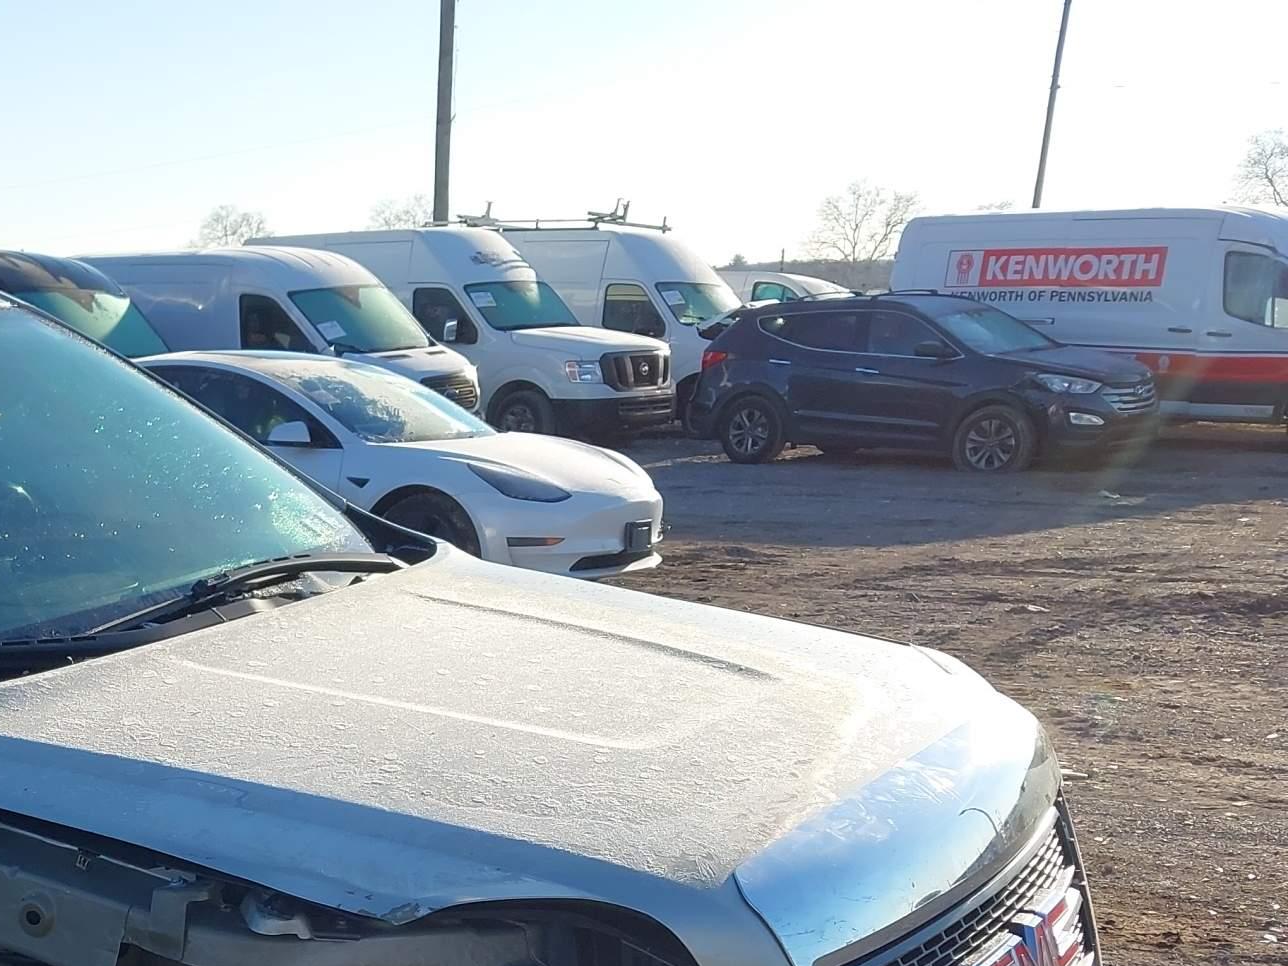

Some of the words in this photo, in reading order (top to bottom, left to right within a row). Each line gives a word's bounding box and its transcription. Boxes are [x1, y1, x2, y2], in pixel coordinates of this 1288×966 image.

[985, 253, 1161, 281] KENWORTH
[1028, 290, 1047, 302] OF
[1050, 290, 1154, 303] PENNSYLVANIA
